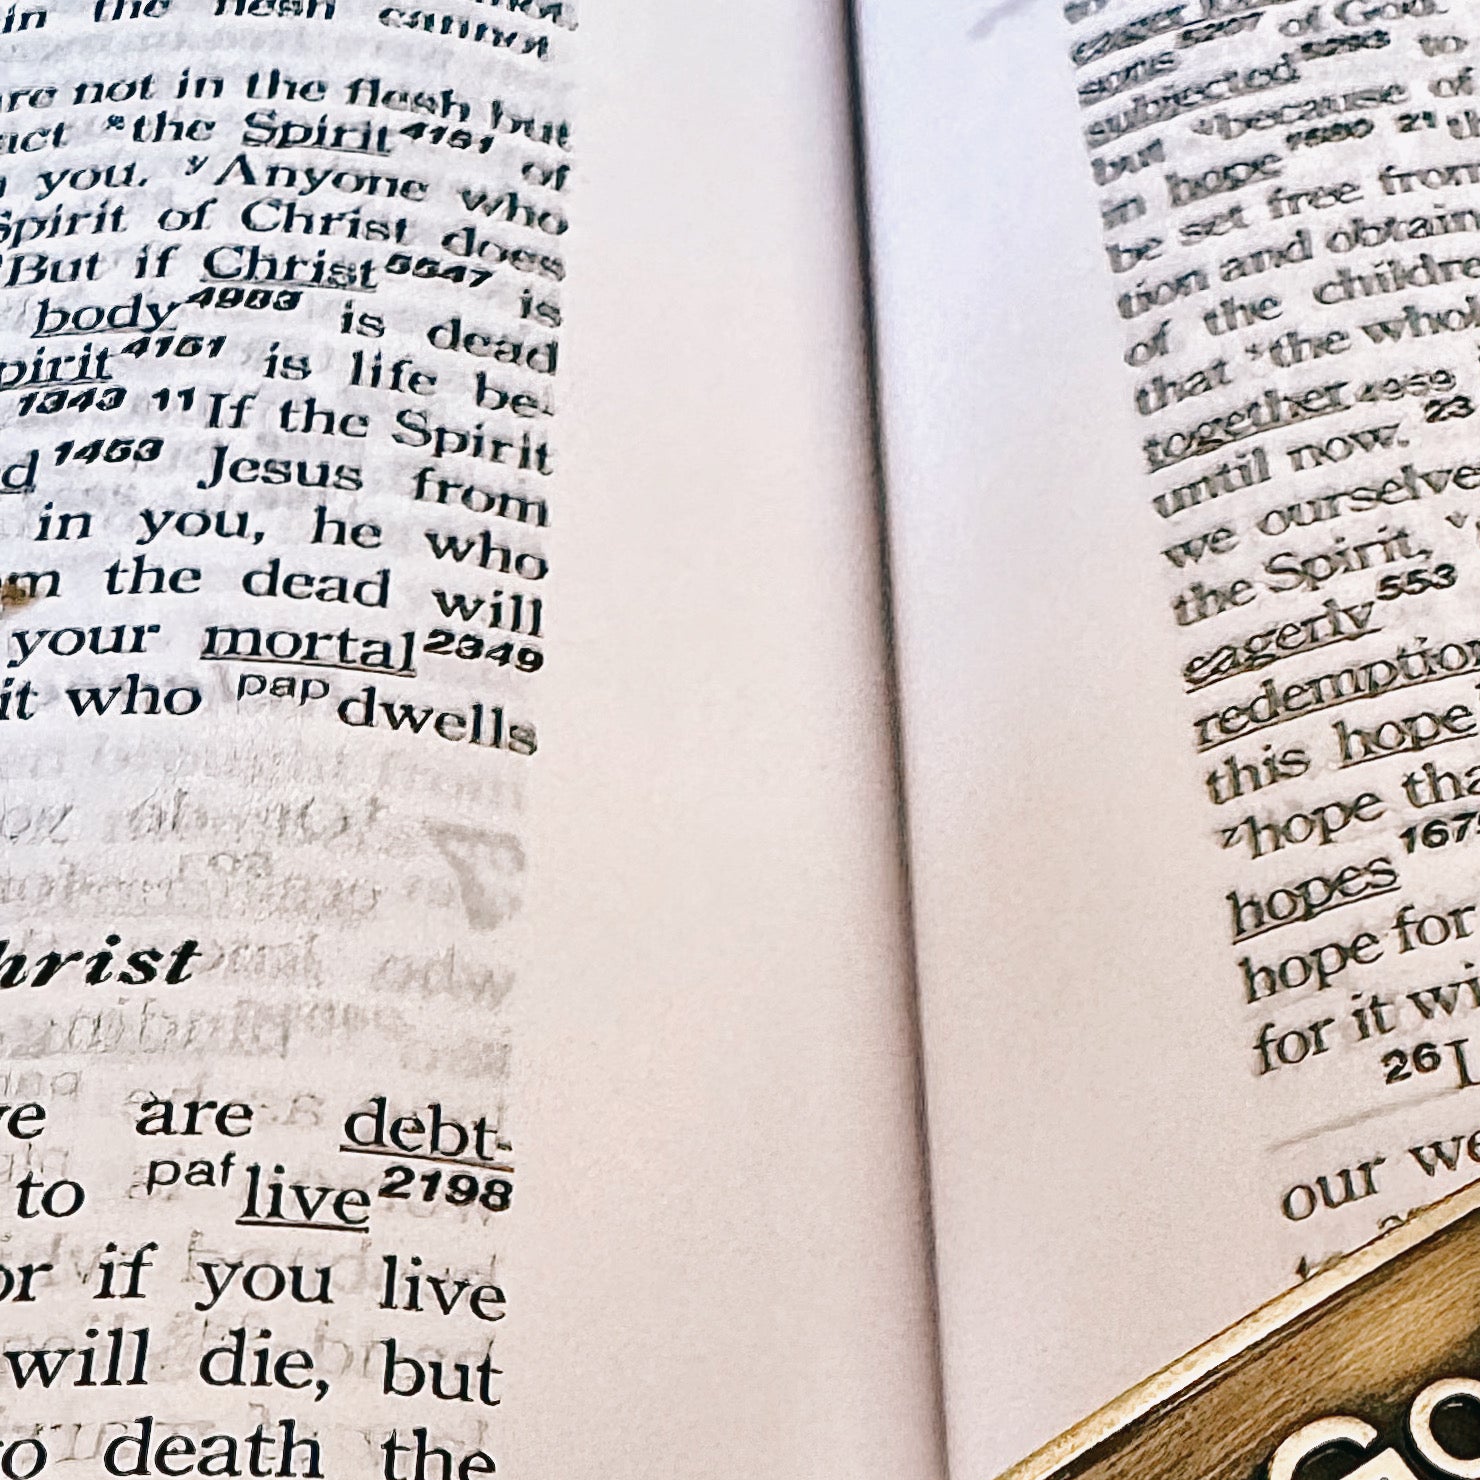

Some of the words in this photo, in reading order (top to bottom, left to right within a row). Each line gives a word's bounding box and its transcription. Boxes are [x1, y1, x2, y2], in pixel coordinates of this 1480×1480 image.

[242, 203, 409, 245] Christ
[459, 190, 569, 236] who
[340, 303, 385, 340] is
[428, 316, 557, 375] dead
[520, 290, 562, 327] is
[264, 342, 311, 381] is
[350, 350, 437, 395] life
[279, 398, 369, 437] the
[392, 409, 555, 476] Spirit
[199, 444, 364, 490] Jesus
[412, 468, 550, 528] from
[34, 505, 93, 543] in
[137, 506, 266, 547] you,
[311, 507, 381, 550] he
[425, 528, 550, 579] who
[105, 556, 202, 594] the
[242, 559, 391, 608] dead
[431, 586, 544, 638] will
[8, 622, 161, 668] your
[65, 675, 202, 719] who
[1206, 743, 1312, 805] this
[1239, 929, 1385, 1004] hope
[1391, 902, 1476, 953] for
[1253, 1013, 1337, 1075] for
[1352, 994, 1398, 1042] it
[137, 1097, 253, 1136] are
[344, 1097, 513, 1161] debt-
[16, 1173, 85, 1219] to
[240, 1164, 372, 1224] live
[379, 1165, 513, 1212] 2198
[1280, 1157, 1386, 1223] our
[94, 1242, 158, 1299] if
[196, 1258, 334, 1310] you
[380, 1253, 506, 1321] live
[5, 1328, 149, 1388] will
[199, 1328, 330, 1402] die,
[382, 1338, 502, 1406] but
[104, 1416, 324, 1480] death
